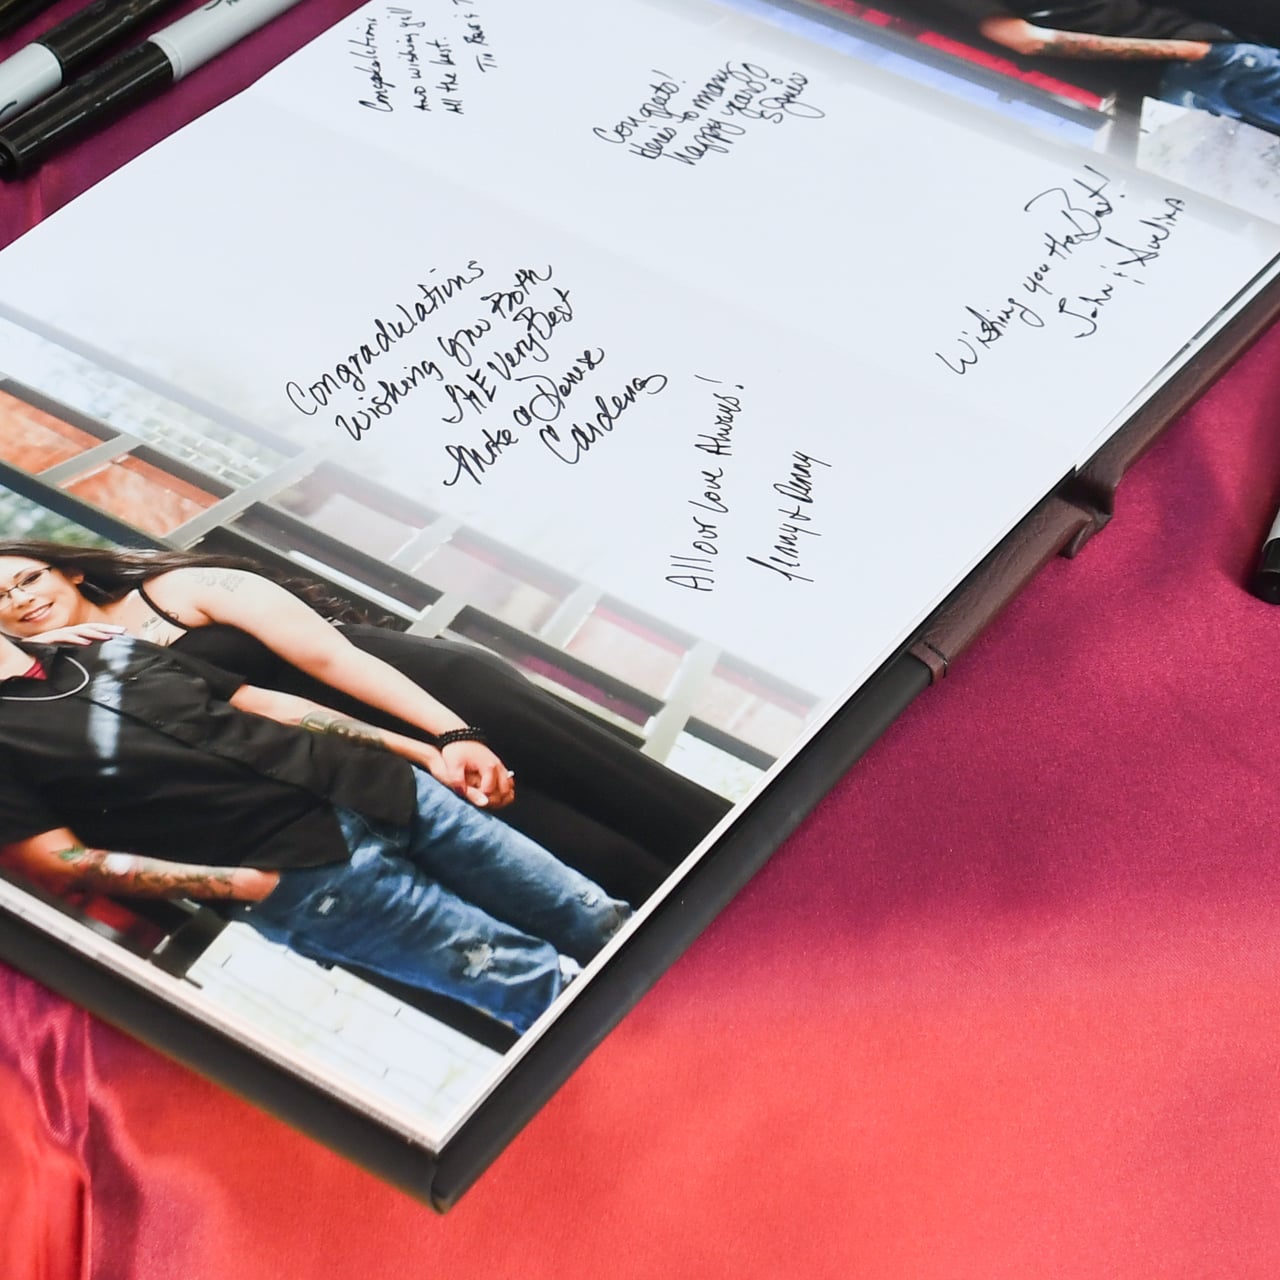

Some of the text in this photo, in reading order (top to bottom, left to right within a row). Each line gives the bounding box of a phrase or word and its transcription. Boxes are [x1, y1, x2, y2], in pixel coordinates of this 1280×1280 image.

[435, 72, 459, 92] the
[512, 287, 574, 340] Best
[935, 297, 1045, 375] Wishing
[1023, 263, 1053, 295] you
[1043, 232, 1078, 261] the
[1058, 283, 1114, 339] John
[538, 372, 669, 466] Cardenas
[665, 554, 715, 592] All
